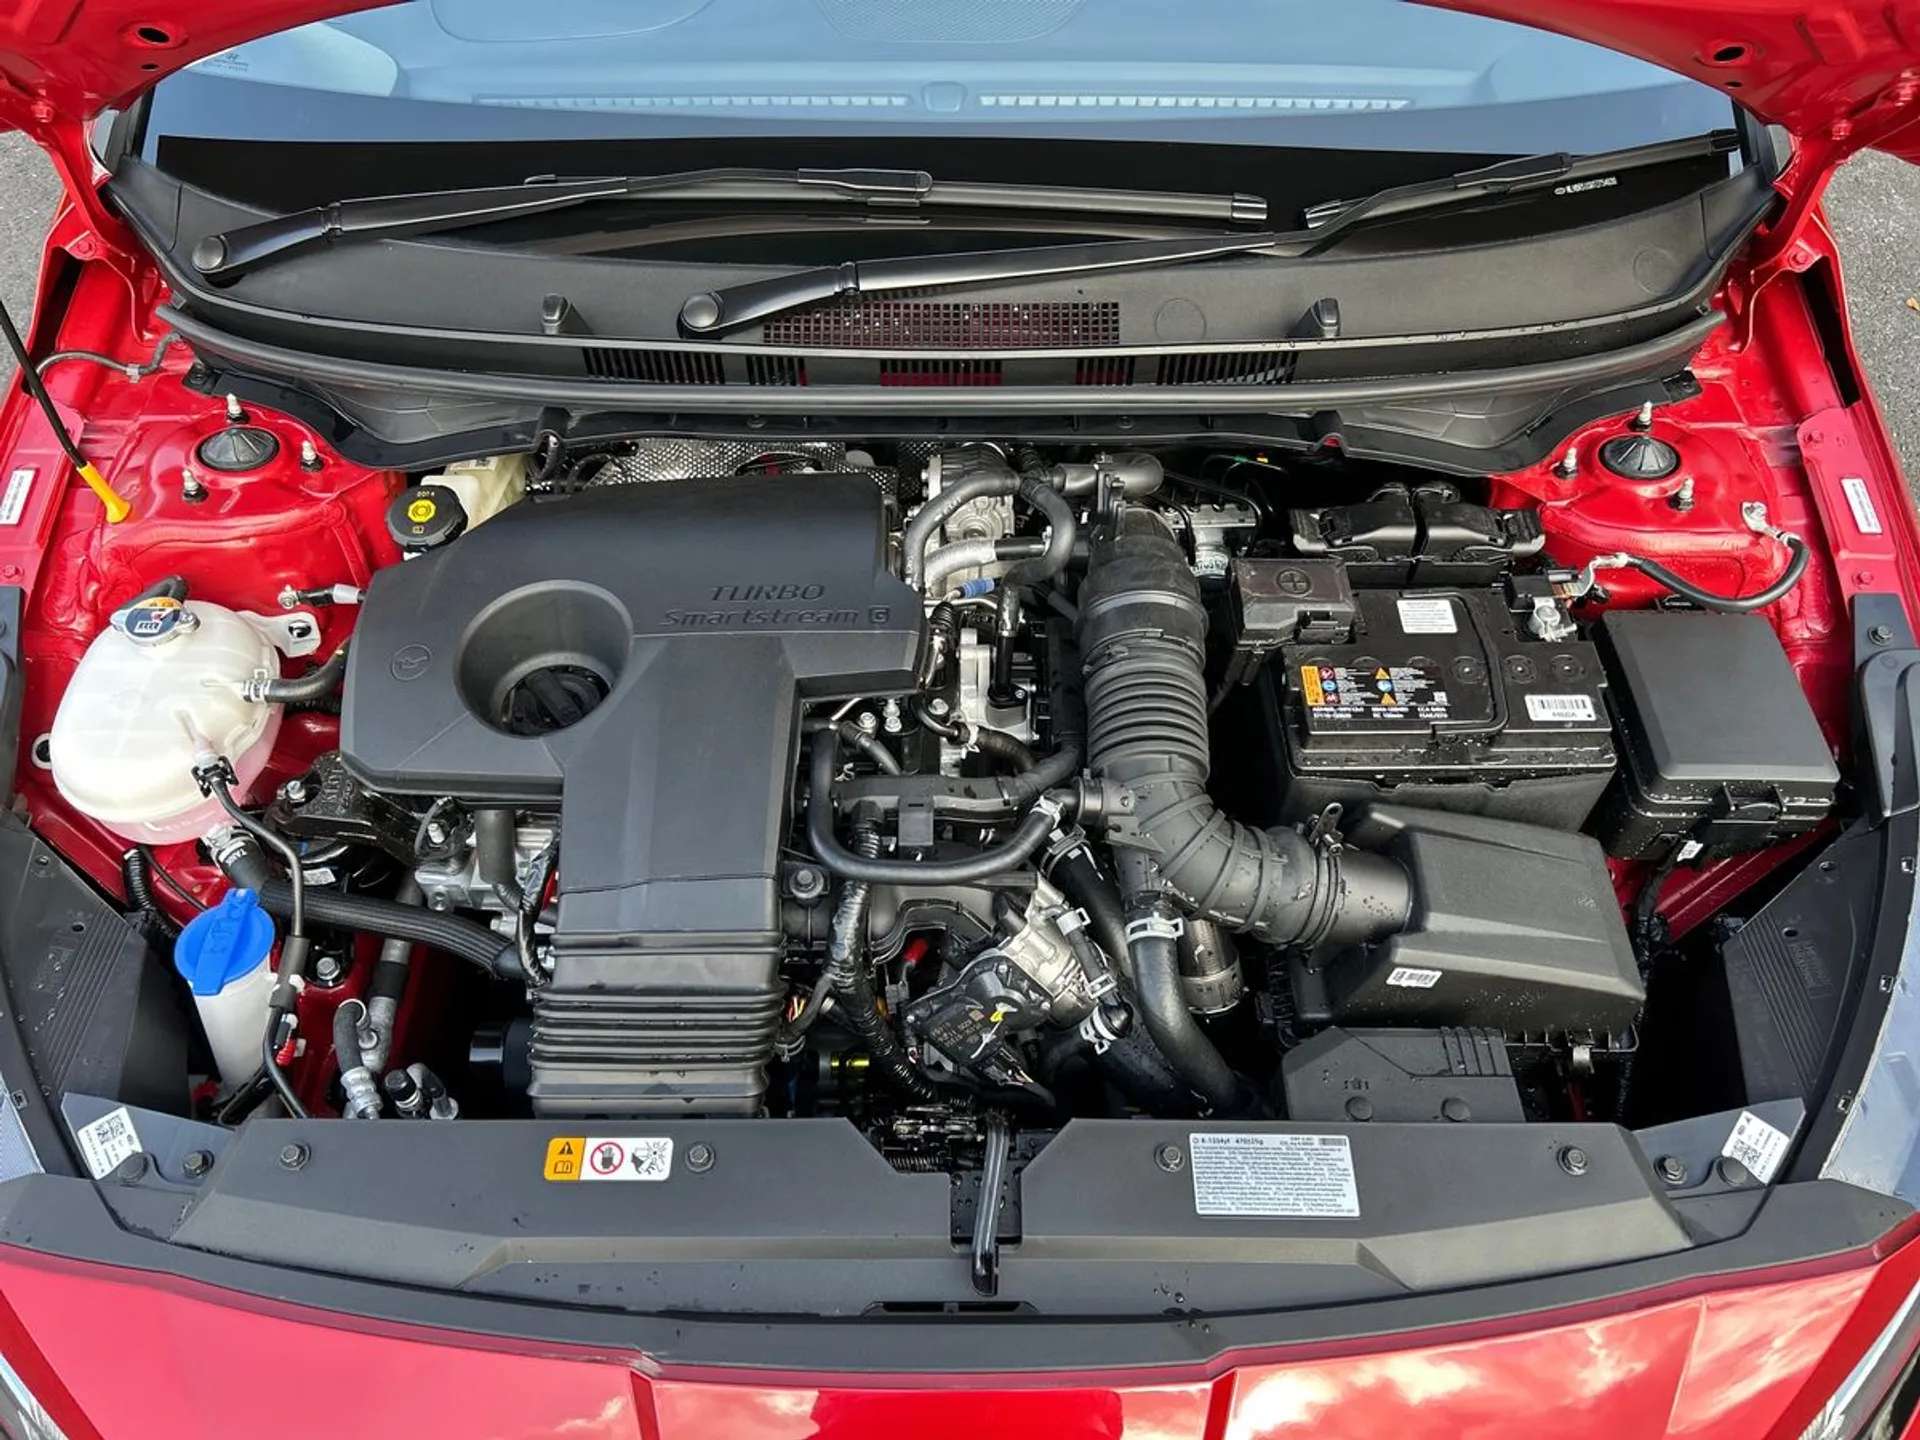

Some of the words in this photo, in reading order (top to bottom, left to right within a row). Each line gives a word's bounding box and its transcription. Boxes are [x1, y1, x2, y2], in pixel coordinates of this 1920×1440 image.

[710, 583, 826, 602] TURBO
[659, 608, 859, 628] Smartstream
[867, 605, 891, 625] G
